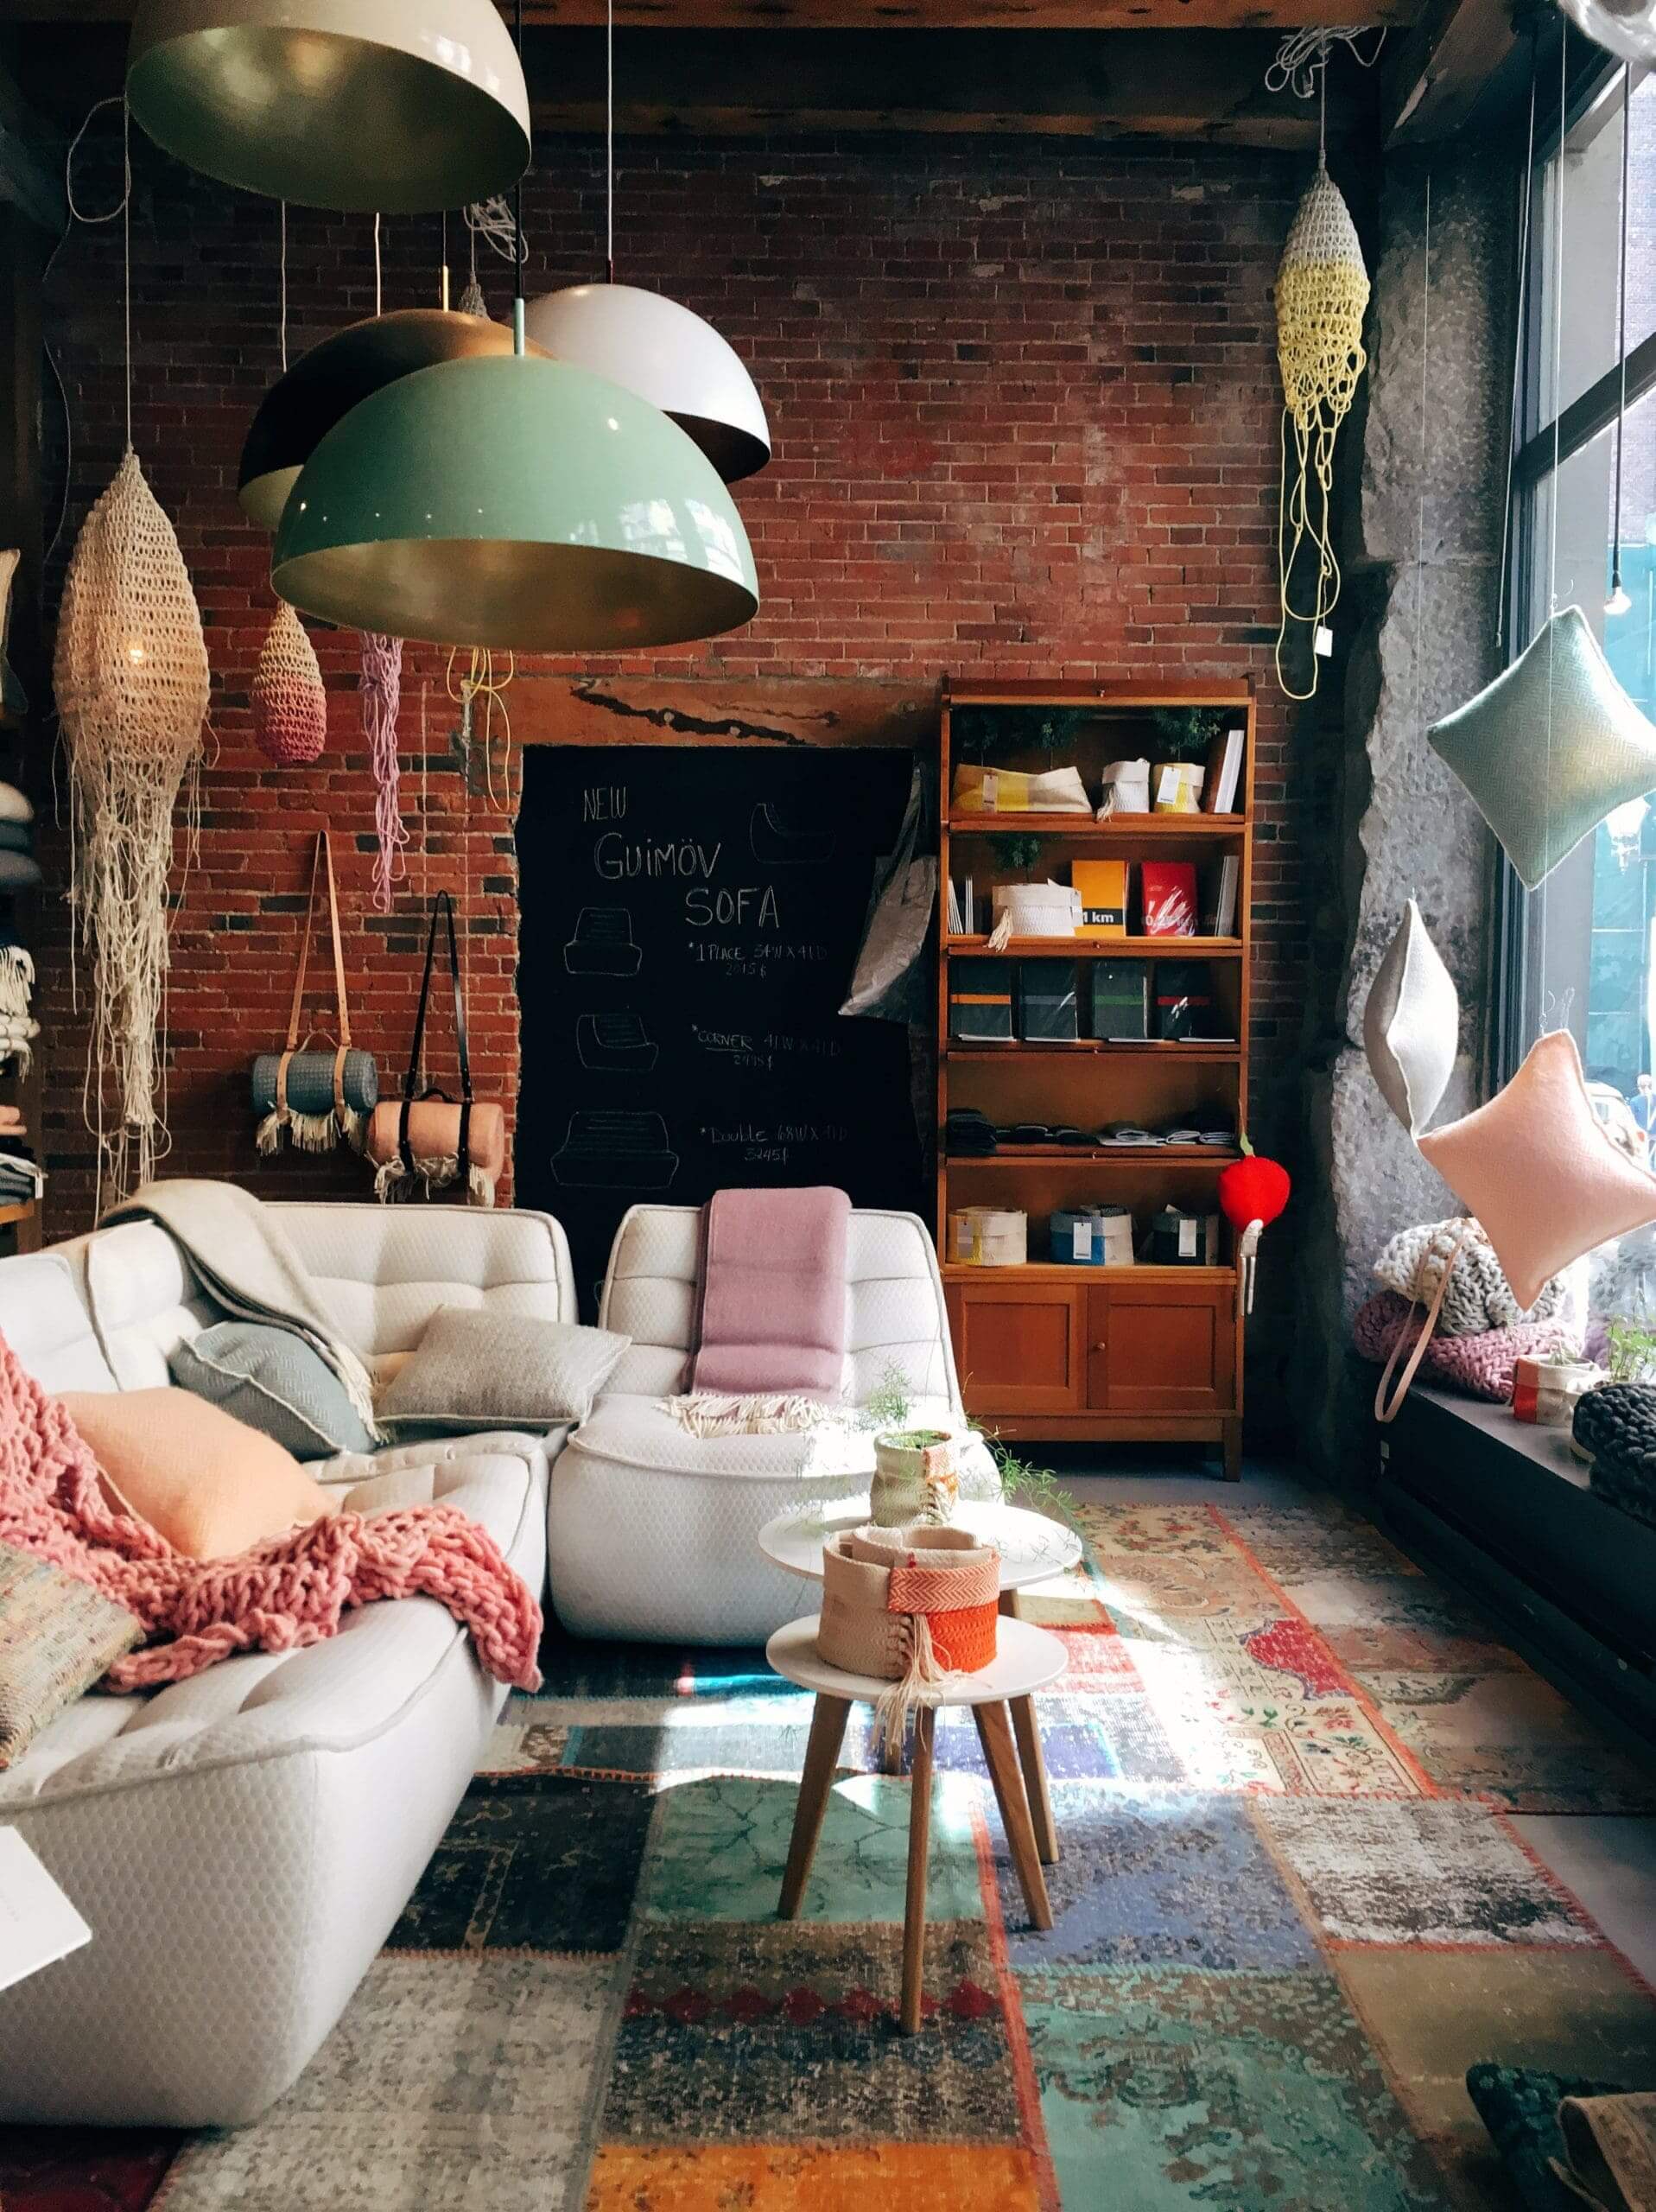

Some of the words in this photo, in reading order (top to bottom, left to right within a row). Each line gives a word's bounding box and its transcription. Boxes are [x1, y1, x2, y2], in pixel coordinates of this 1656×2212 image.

[583, 785, 627, 823] NEW
[685, 884, 781, 929] SOFA
[1092, 911, 1114, 924] km
[697, 1029, 754, 1052] CORNER
